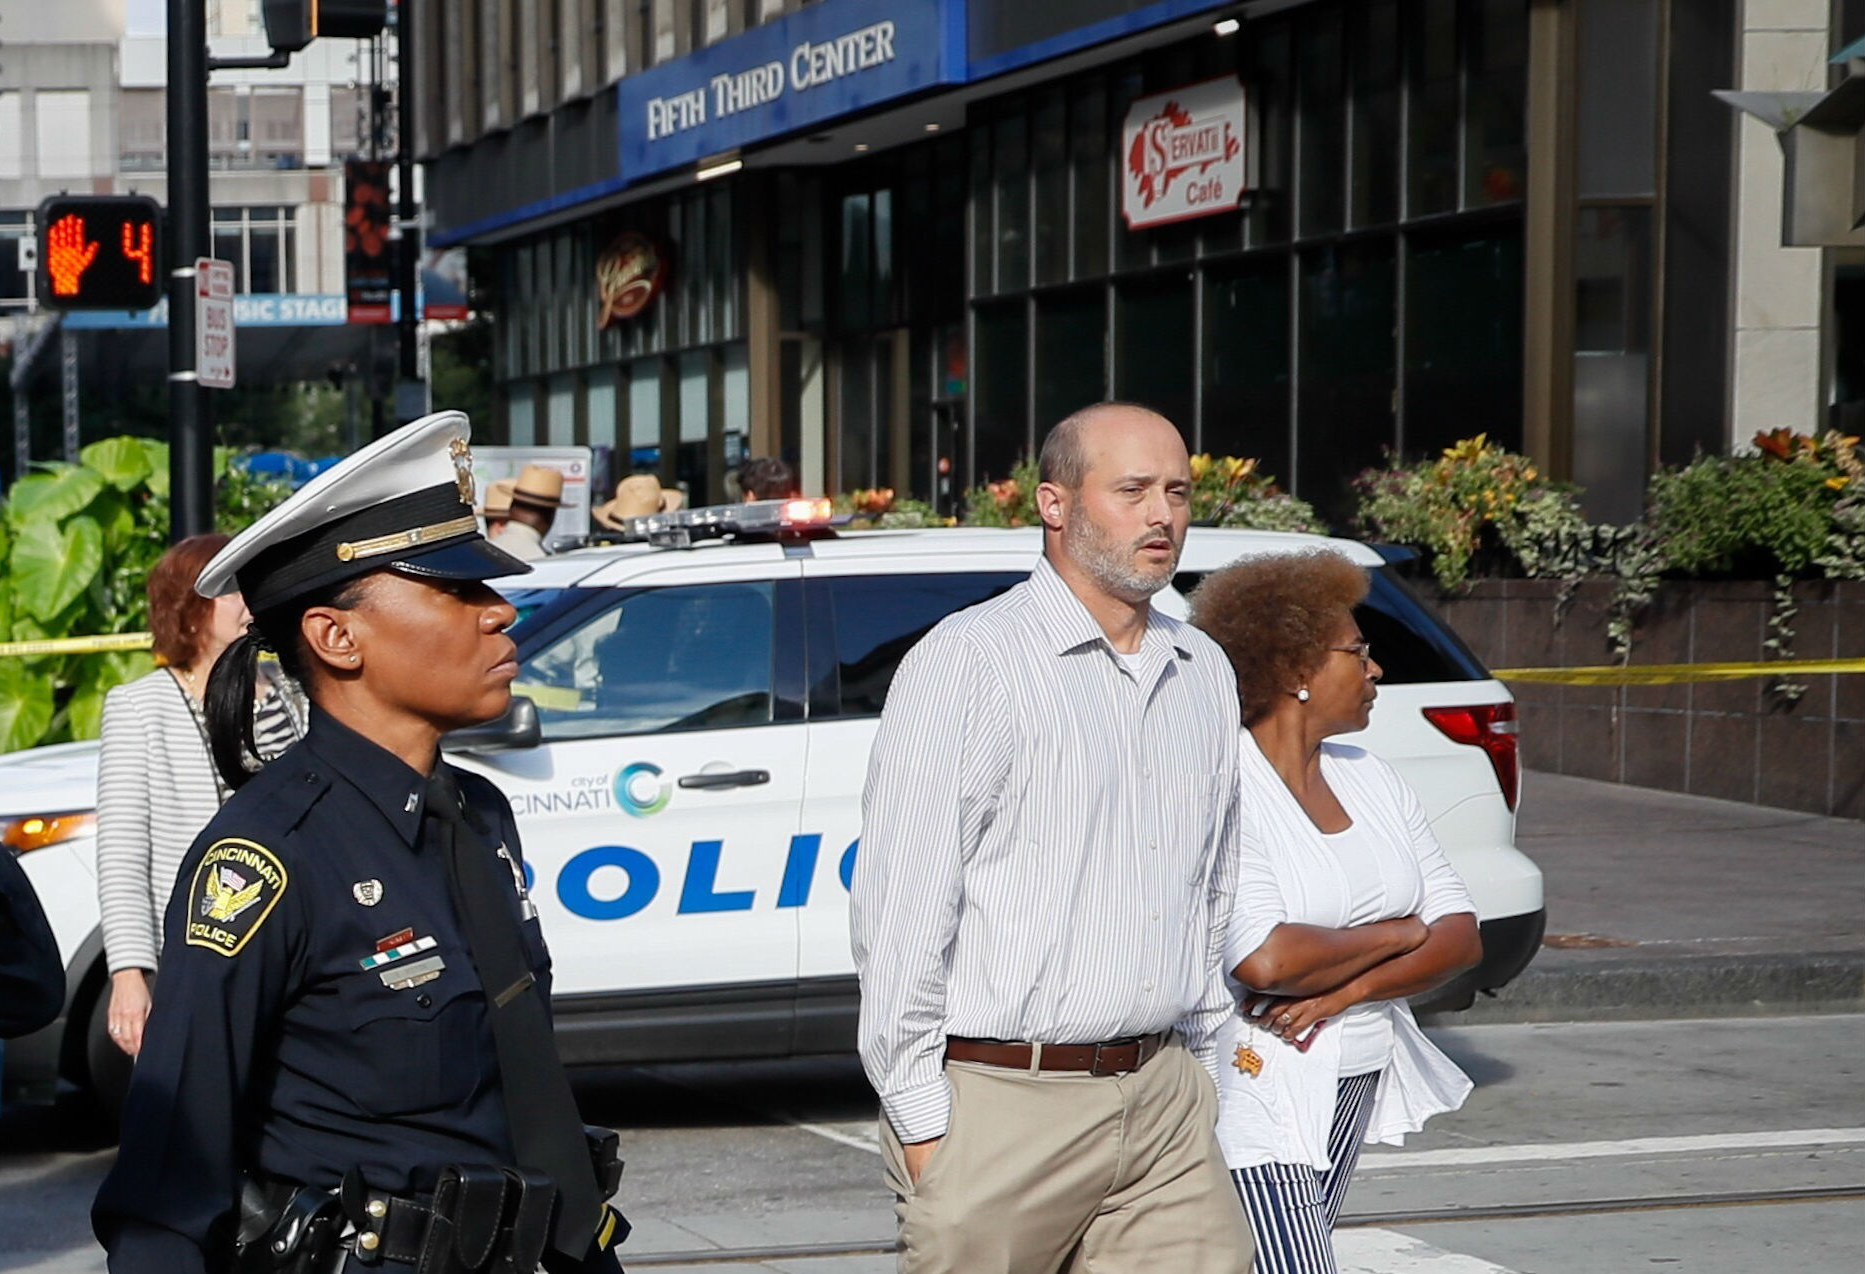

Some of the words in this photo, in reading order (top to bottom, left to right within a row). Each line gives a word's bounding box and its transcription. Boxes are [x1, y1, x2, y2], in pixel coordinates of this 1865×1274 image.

[647, 87, 707, 141] FIFTH
[710, 60, 786, 119] THIRD
[790, 19, 896, 92] CENTER
[1185, 175, 1223, 206] Café
[121, 220, 153, 285] 4
[207, 306, 227, 330] BUS
[205, 334, 230, 358] STOP
[571, 776, 595, 789] city
[596, 774, 609, 786] of
[522, 832, 861, 922] OLI
[190, 922, 238, 949] POLICE
